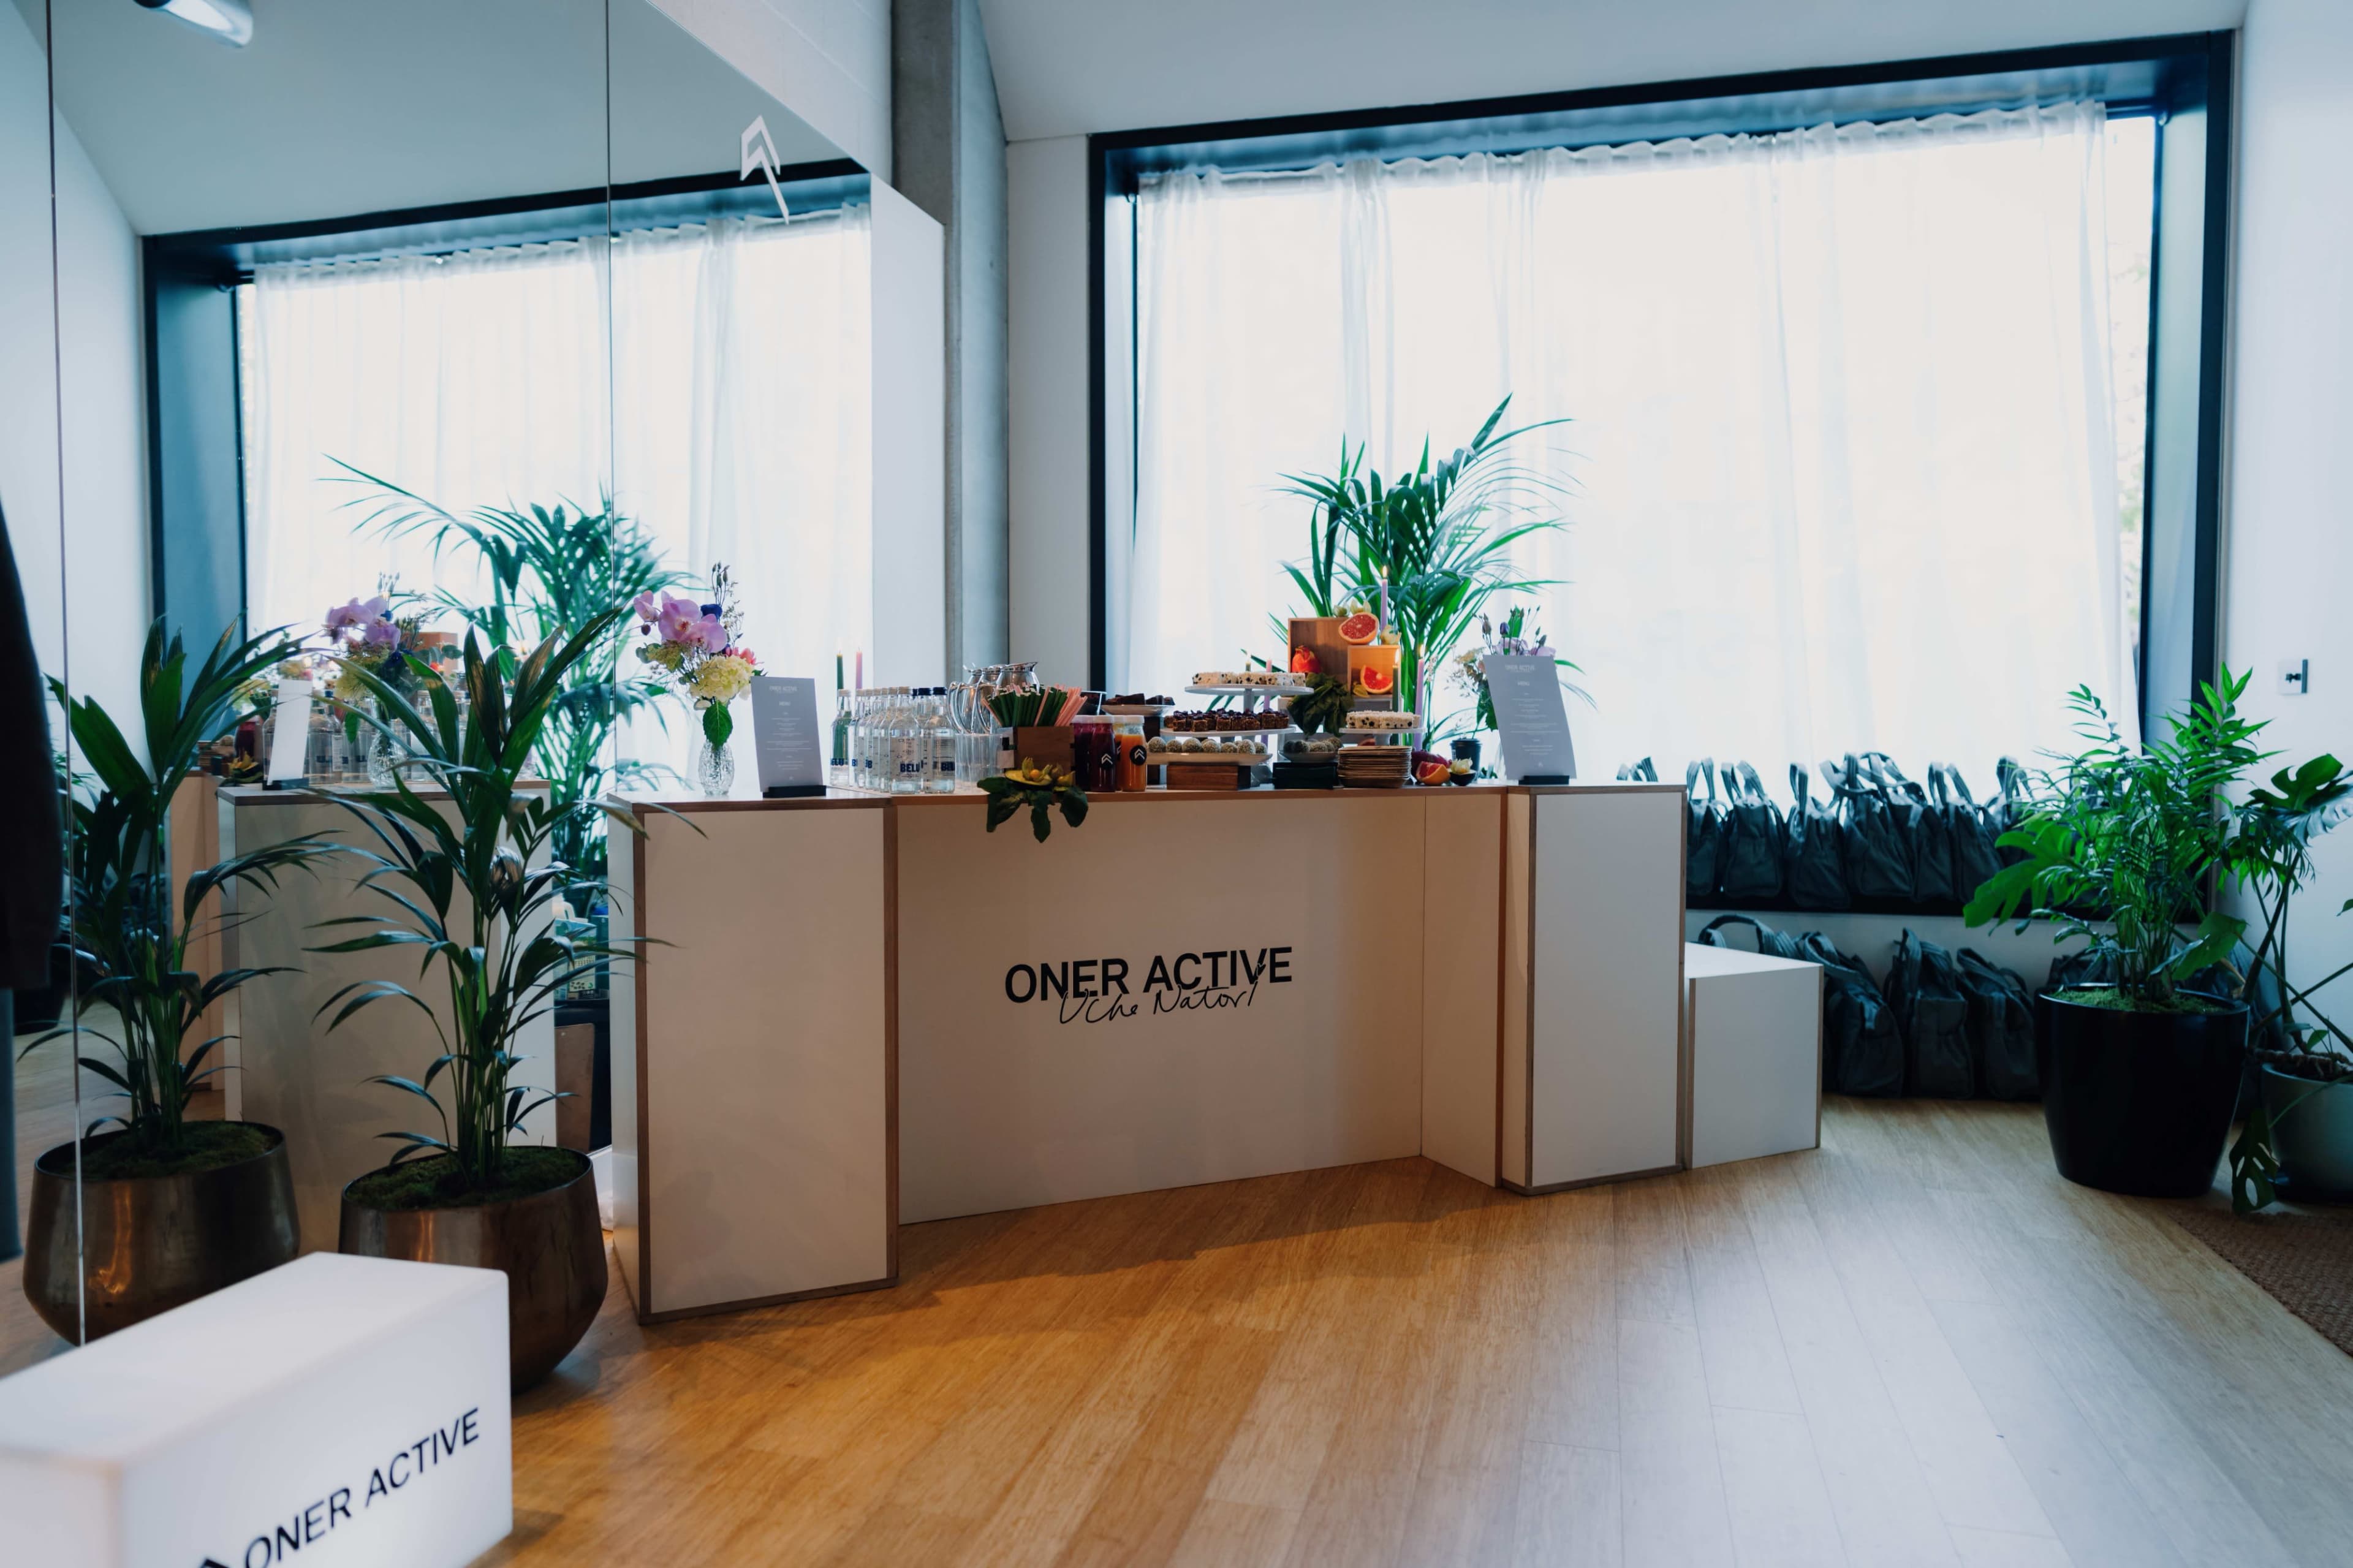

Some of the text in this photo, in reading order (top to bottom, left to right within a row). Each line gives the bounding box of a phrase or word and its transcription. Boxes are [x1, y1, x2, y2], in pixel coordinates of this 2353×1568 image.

[900, 762, 920, 773] BELU
[1006, 947, 1292, 1003] ONER ACTIVE
[244, 1407, 479, 1568] ONER ACTIVE
